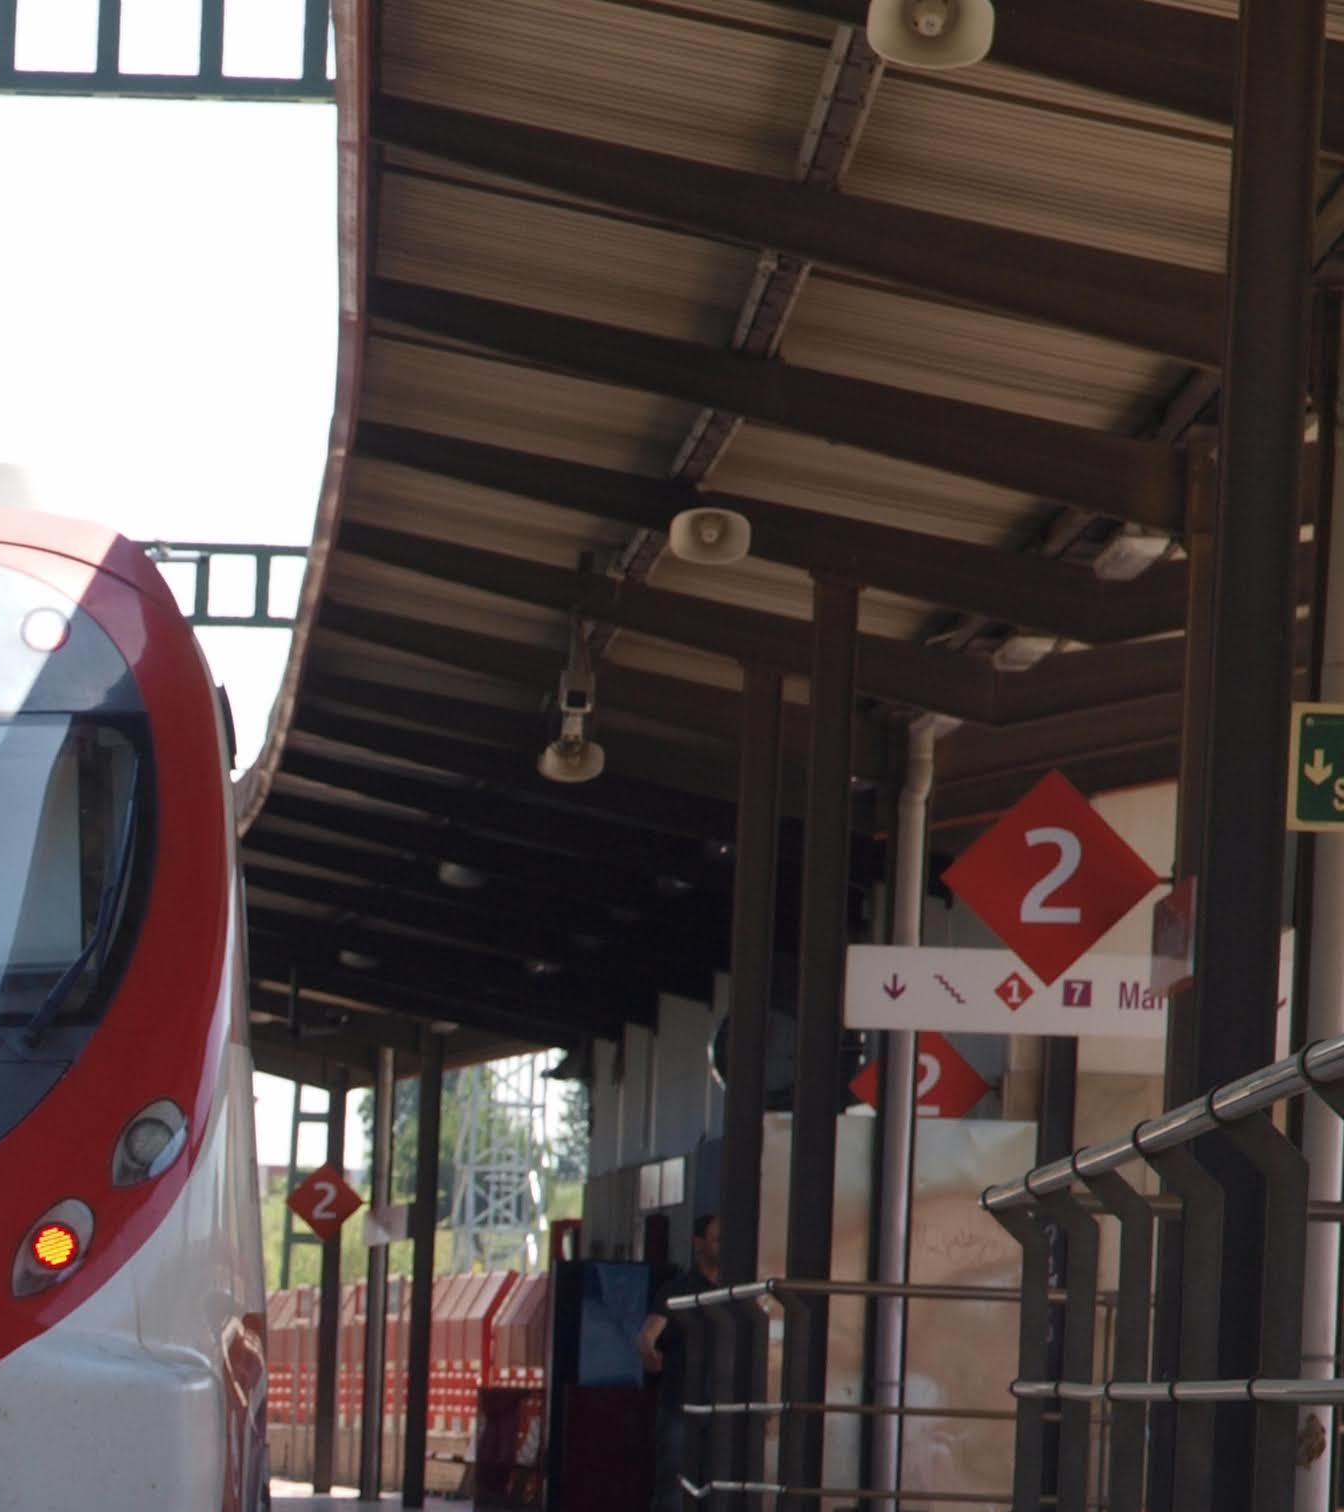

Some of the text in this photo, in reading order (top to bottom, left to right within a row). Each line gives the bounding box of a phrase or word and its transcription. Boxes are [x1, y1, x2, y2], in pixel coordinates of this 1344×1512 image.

[1020, 826, 1081, 924] 2
[1008, 979, 1021, 1004] 1
[1071, 983, 1085, 1004] 7
[313, 1181, 337, 1220] 2
